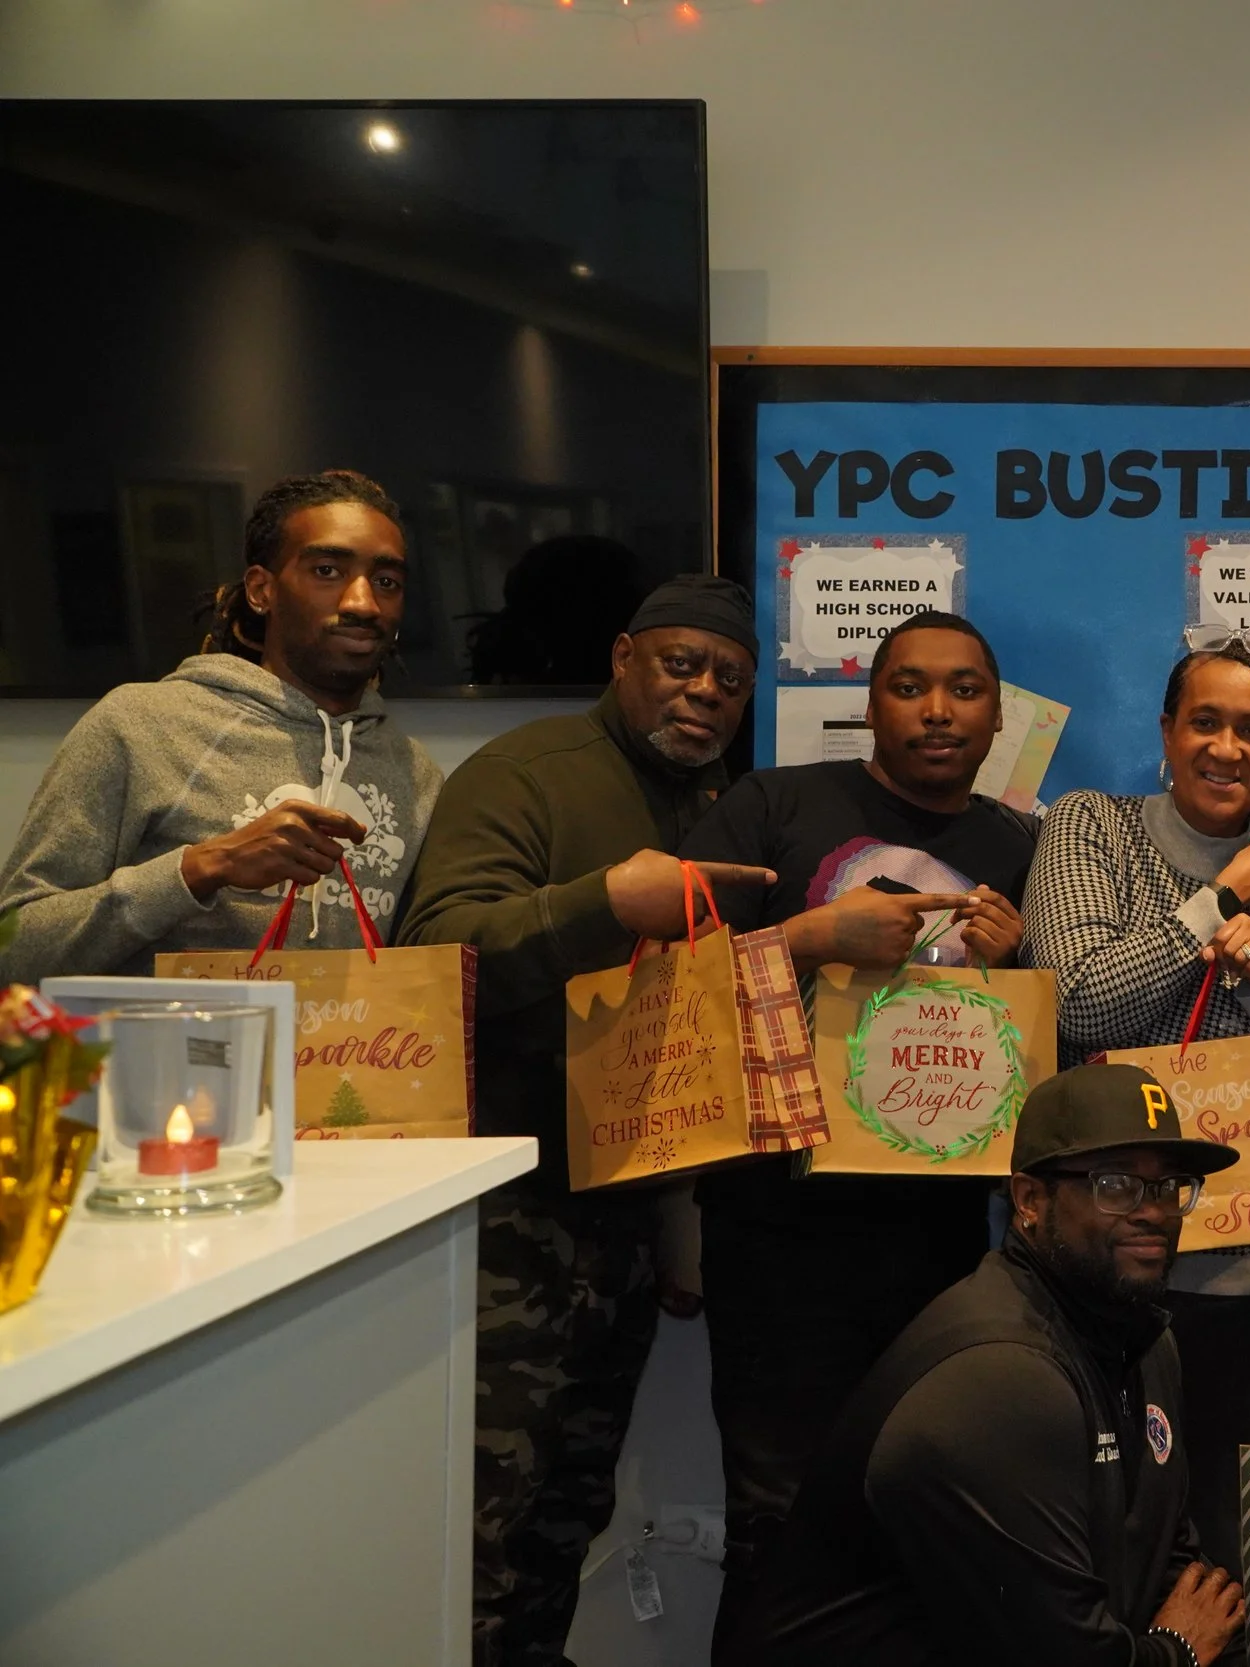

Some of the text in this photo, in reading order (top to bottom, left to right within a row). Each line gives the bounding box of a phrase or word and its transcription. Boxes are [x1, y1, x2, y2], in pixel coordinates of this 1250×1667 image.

[775, 450, 955, 518] YPC
[817, 580, 937, 592] WE EARNED A
[1220, 569, 1245, 580] WE
[816, 603, 860, 615] HIGH
[639, 986, 684, 1014] HAVE
[918, 1004, 961, 1021] MAY
[600, 991, 707, 1072] yourself
[890, 1022, 988, 1043] your days be
[294, 1027, 436, 1078] parkle
[628, 1040, 694, 1070] A MERRY
[891, 1044, 985, 1071] MERRY
[1170, 1053, 1207, 1075] the
[925, 1073, 953, 1085] AND
[877, 1076, 996, 1126] Bright
[1141, 1083, 1168, 1130] P
[592, 1096, 725, 1147] CHRISTMAS
